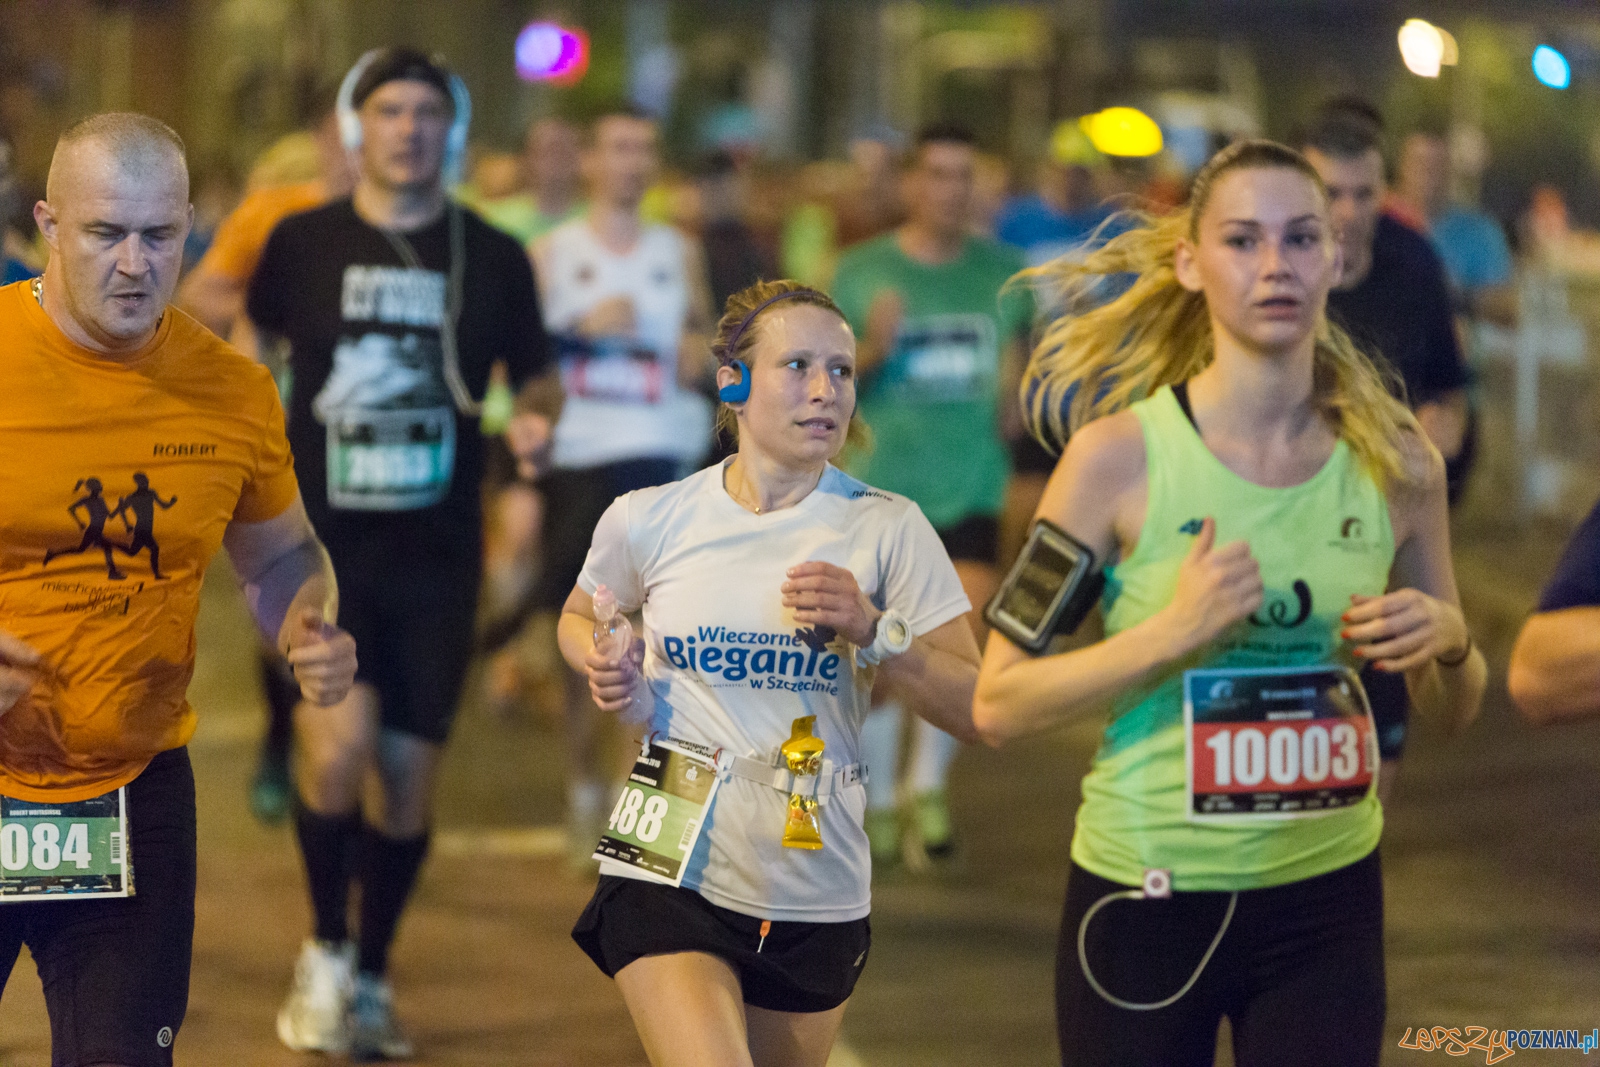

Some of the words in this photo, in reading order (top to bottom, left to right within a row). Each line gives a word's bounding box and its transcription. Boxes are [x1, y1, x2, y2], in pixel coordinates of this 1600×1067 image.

[153, 444, 218, 456] ROBERT
[852, 490, 893, 502] newline
[698, 626, 802, 648] Wieczorne
[663, 635, 840, 681] Bieganie
[750, 679, 763, 690] w
[766, 676, 839, 696] Szczecinie
[1206, 723, 1360, 786] 10003
